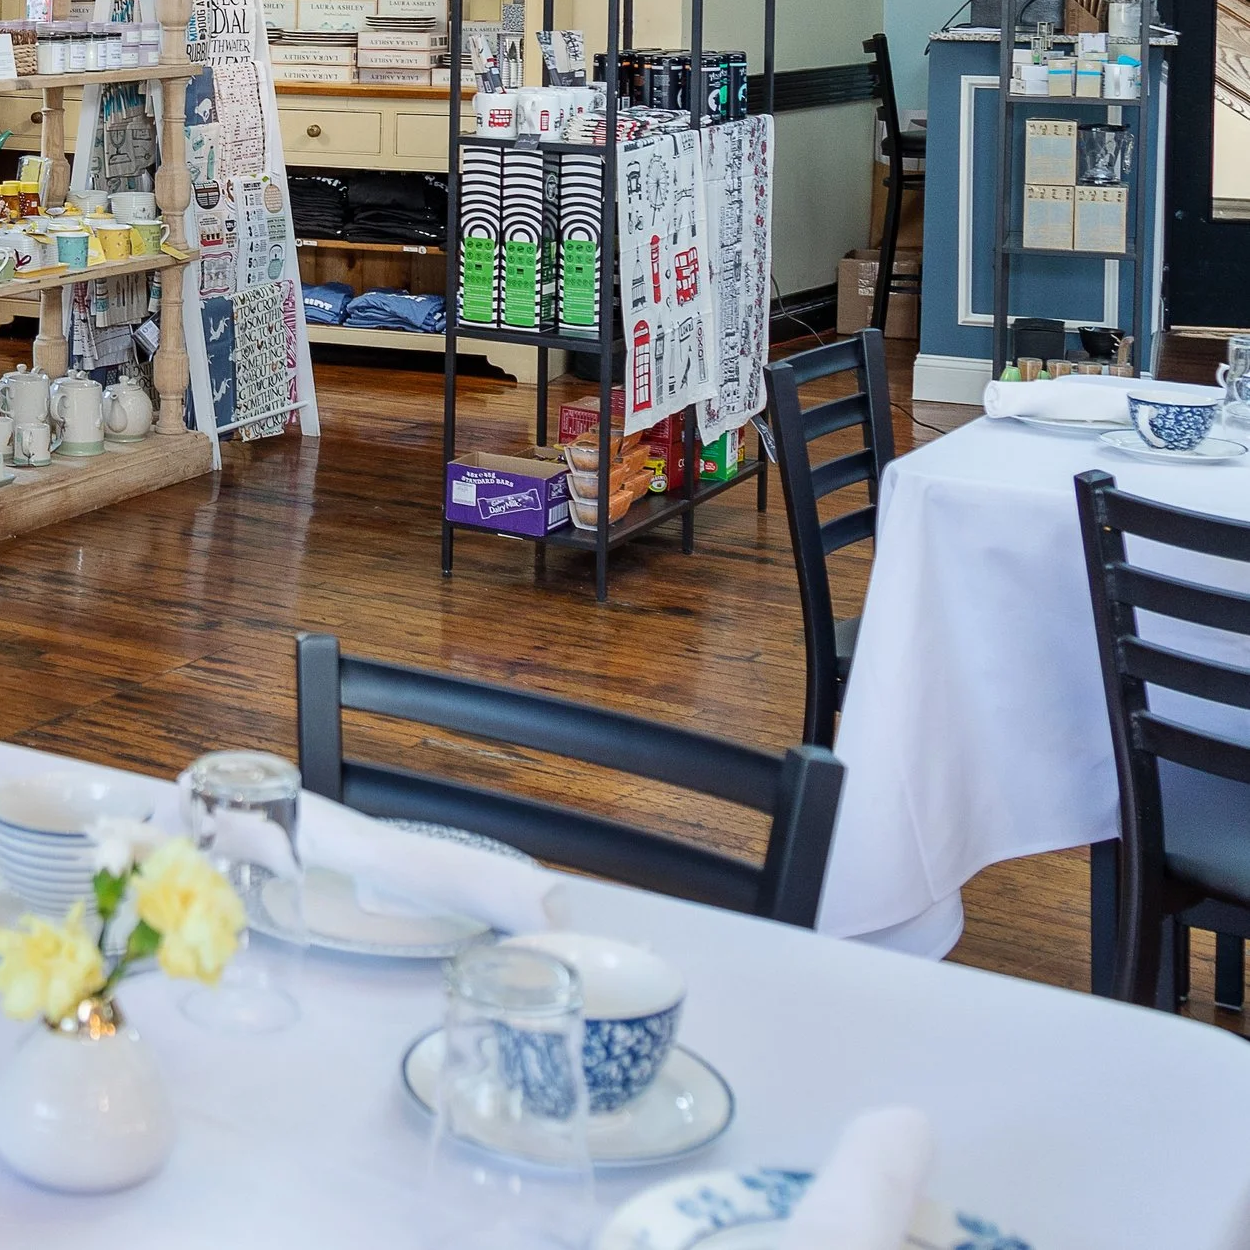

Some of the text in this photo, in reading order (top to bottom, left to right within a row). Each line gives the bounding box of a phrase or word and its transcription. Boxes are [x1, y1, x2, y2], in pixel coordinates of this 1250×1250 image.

[461, 476, 514, 487] STANDARD BARS
[489, 497, 522, 514] Dairy Milk
